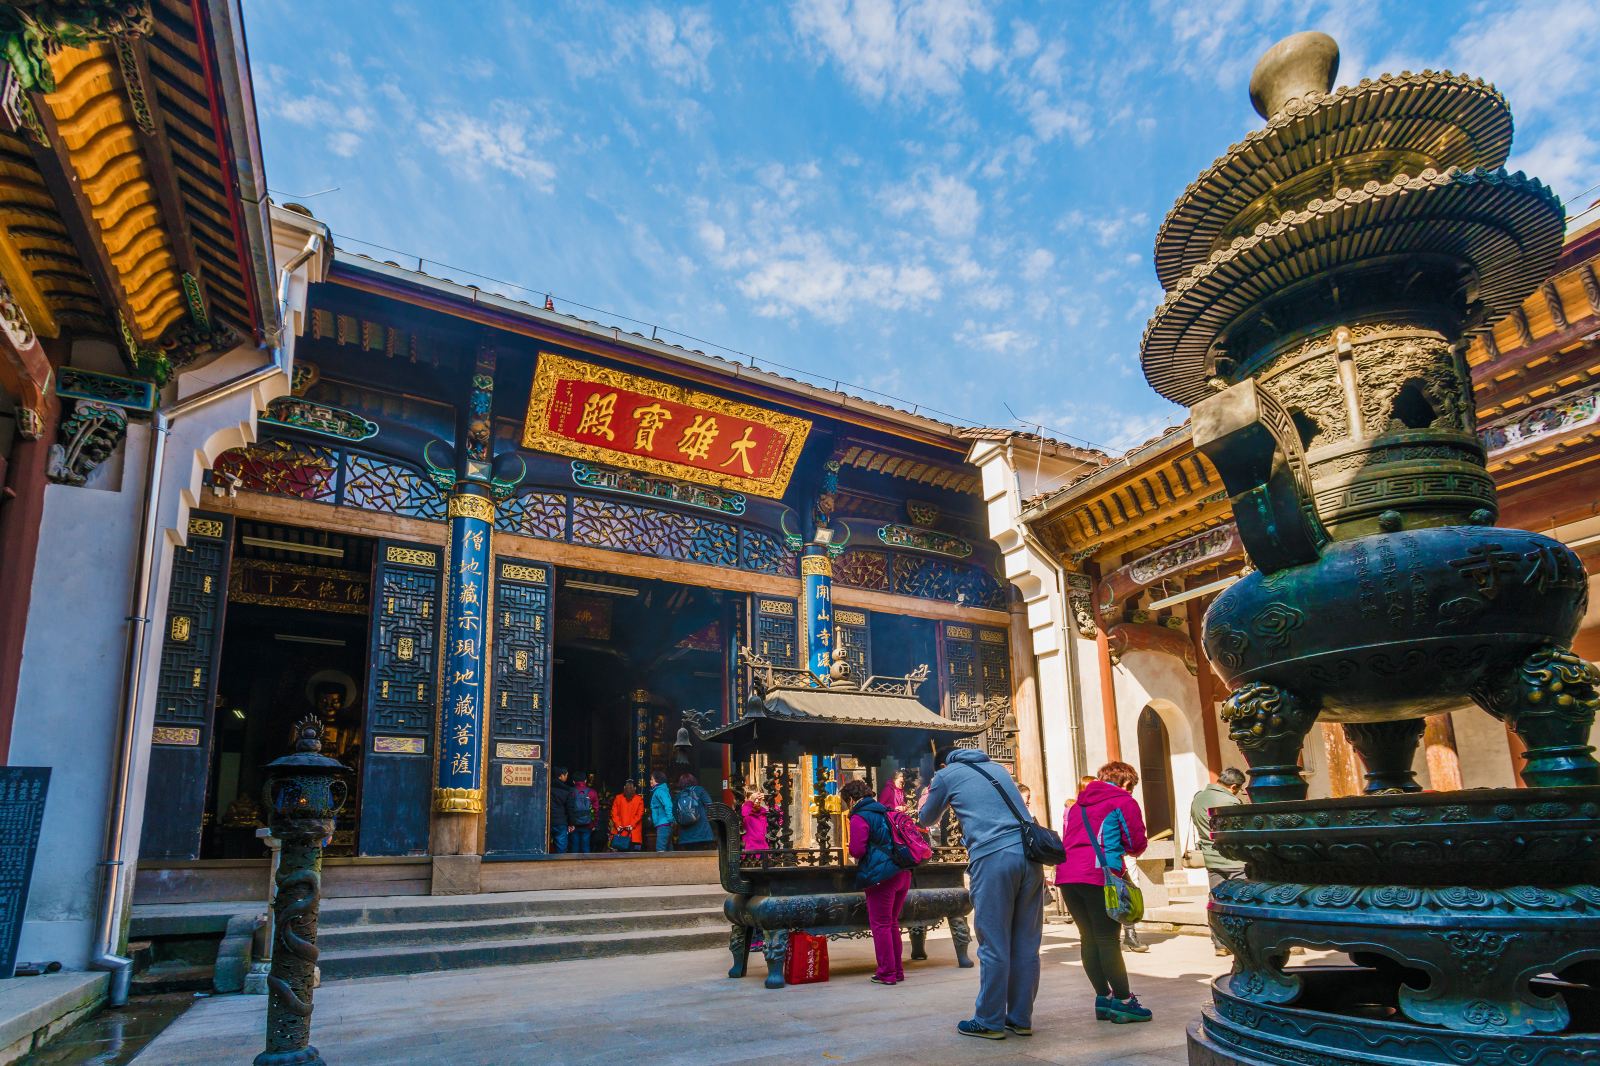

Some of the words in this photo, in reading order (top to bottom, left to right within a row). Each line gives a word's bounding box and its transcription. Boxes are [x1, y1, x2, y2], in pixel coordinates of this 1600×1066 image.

[450, 529, 484, 776] 僧地藏示現地藏菩薩
